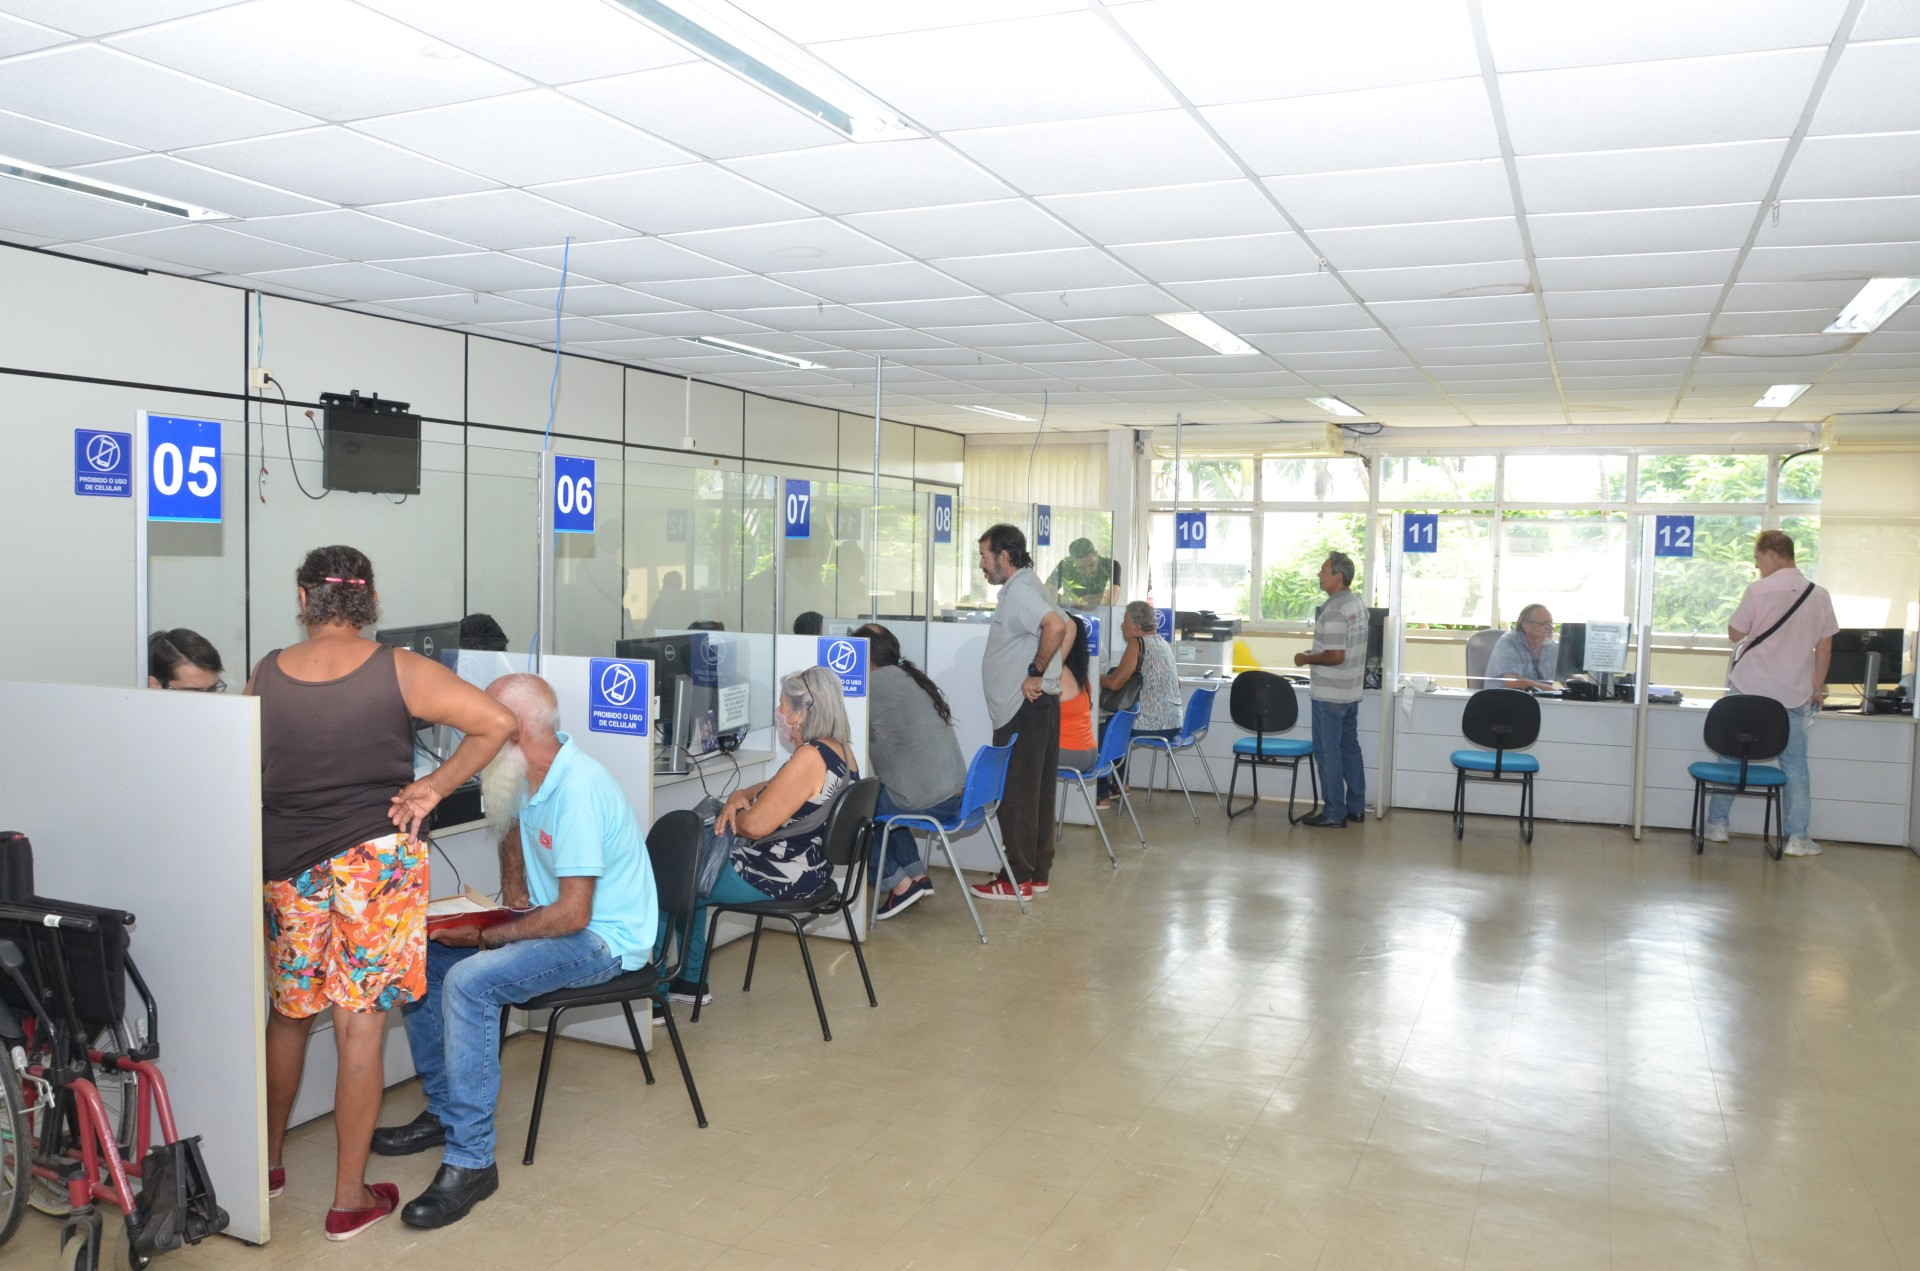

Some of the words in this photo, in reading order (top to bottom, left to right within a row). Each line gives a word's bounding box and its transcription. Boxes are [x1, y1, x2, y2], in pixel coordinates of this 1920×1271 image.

[79, 476, 108, 484] PROIBIDO
[153, 442, 217, 498] 05
[94, 484, 122, 492] CELULAR
[557, 474, 593, 515] 06
[787, 493, 809, 524] 07
[936, 506, 951, 532] 08
[1038, 514, 1050, 537] 09
[1179, 521, 1205, 541] 10
[1409, 523, 1433, 544] 11
[1659, 525, 1691, 547] 12
[593, 710, 622, 720] PROIBIDO
[629, 714, 643, 722] USO
[599, 719, 607, 727] DE
[608, 720, 637, 729] CELULAR
